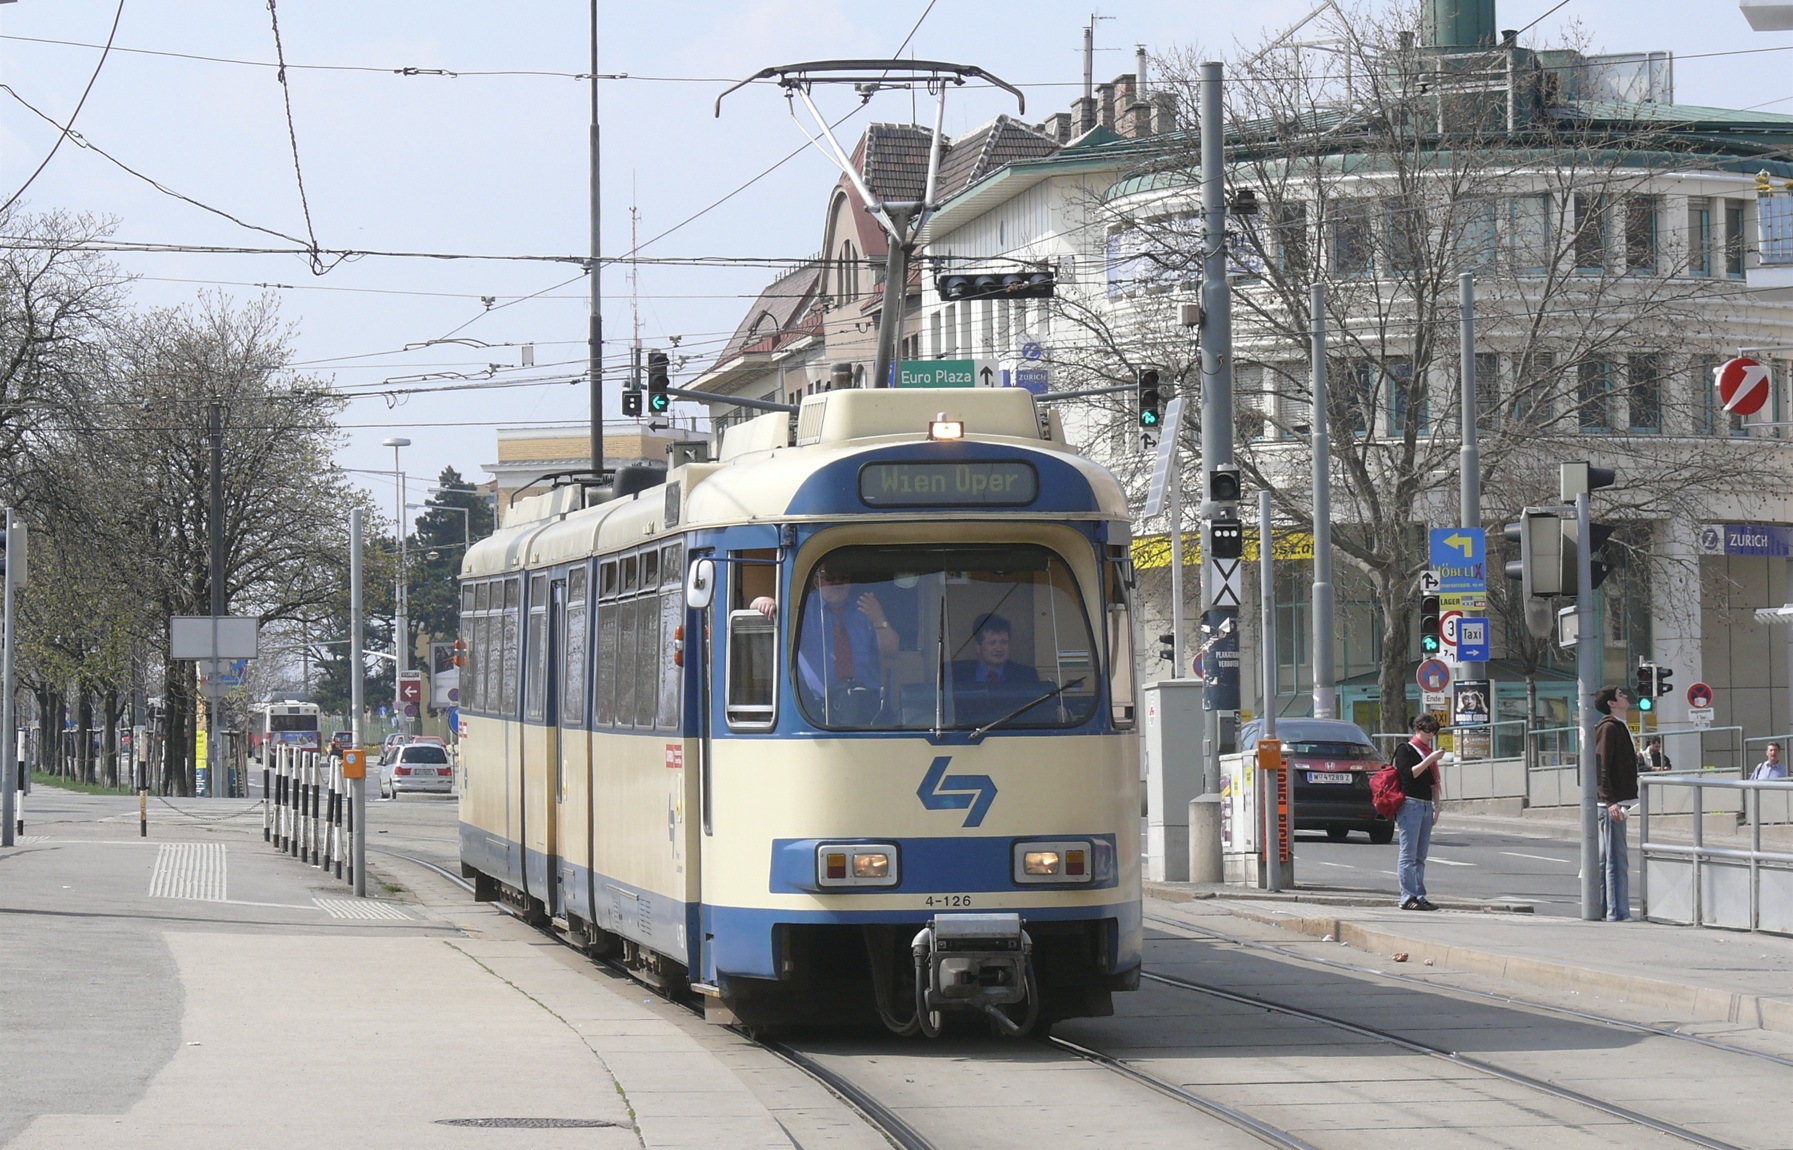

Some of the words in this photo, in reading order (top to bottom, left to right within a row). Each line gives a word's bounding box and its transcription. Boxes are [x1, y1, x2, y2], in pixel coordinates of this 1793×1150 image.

[901, 371, 931, 384] Euro
[936, 370, 972, 384] Plaza
[881, 465, 945, 493] Wien
[956, 464, 1018, 495] Oper
[1440, 598, 1461, 606] LAGER
[1463, 627, 1482, 640] Taxi
[1426, 694, 1441, 703] Ende
[925, 895, 971, 907] 4-126
